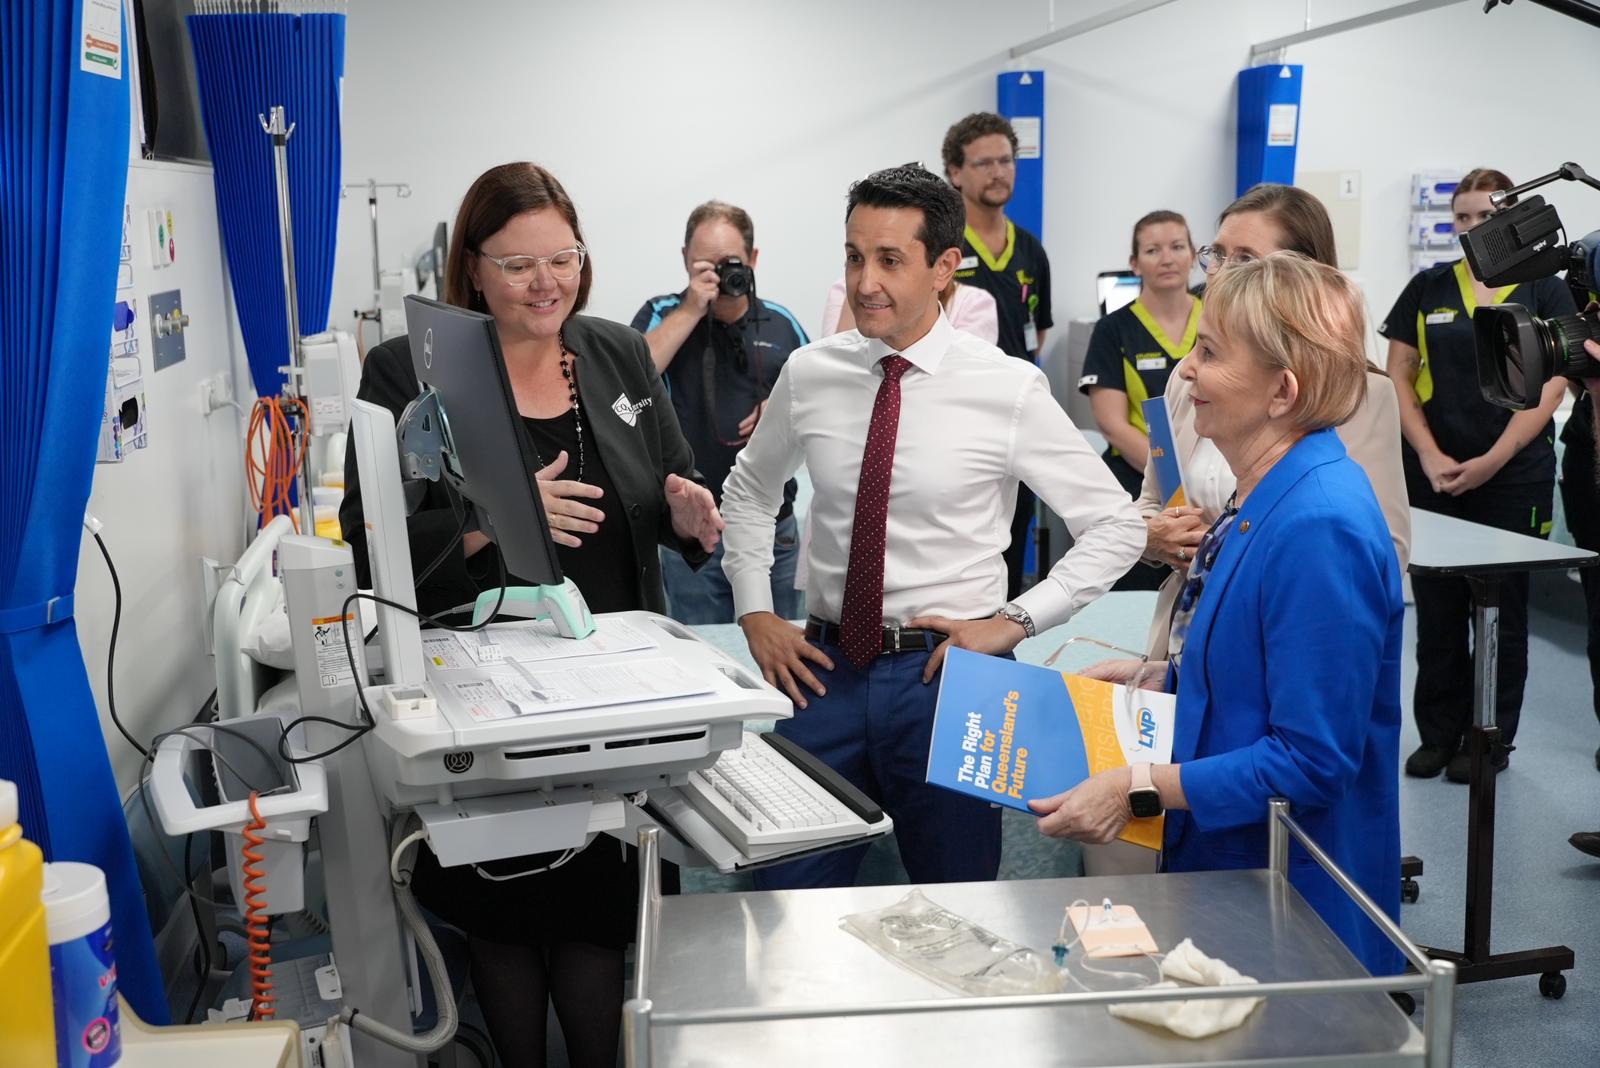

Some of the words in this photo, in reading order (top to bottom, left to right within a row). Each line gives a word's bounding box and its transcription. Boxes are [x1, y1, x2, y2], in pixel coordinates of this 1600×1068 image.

[1344, 179, 1353, 194] 1
[615, 397, 653, 413] CQUersity
[962, 711, 983, 753] Right
[980, 729, 996, 753] for
[991, 690, 1020, 794] Queensland's
[1138, 709, 1156, 749] LNP
[957, 754, 976, 783] The
[974, 755, 993, 790] Plan
[1007, 747, 1029, 800] Future
